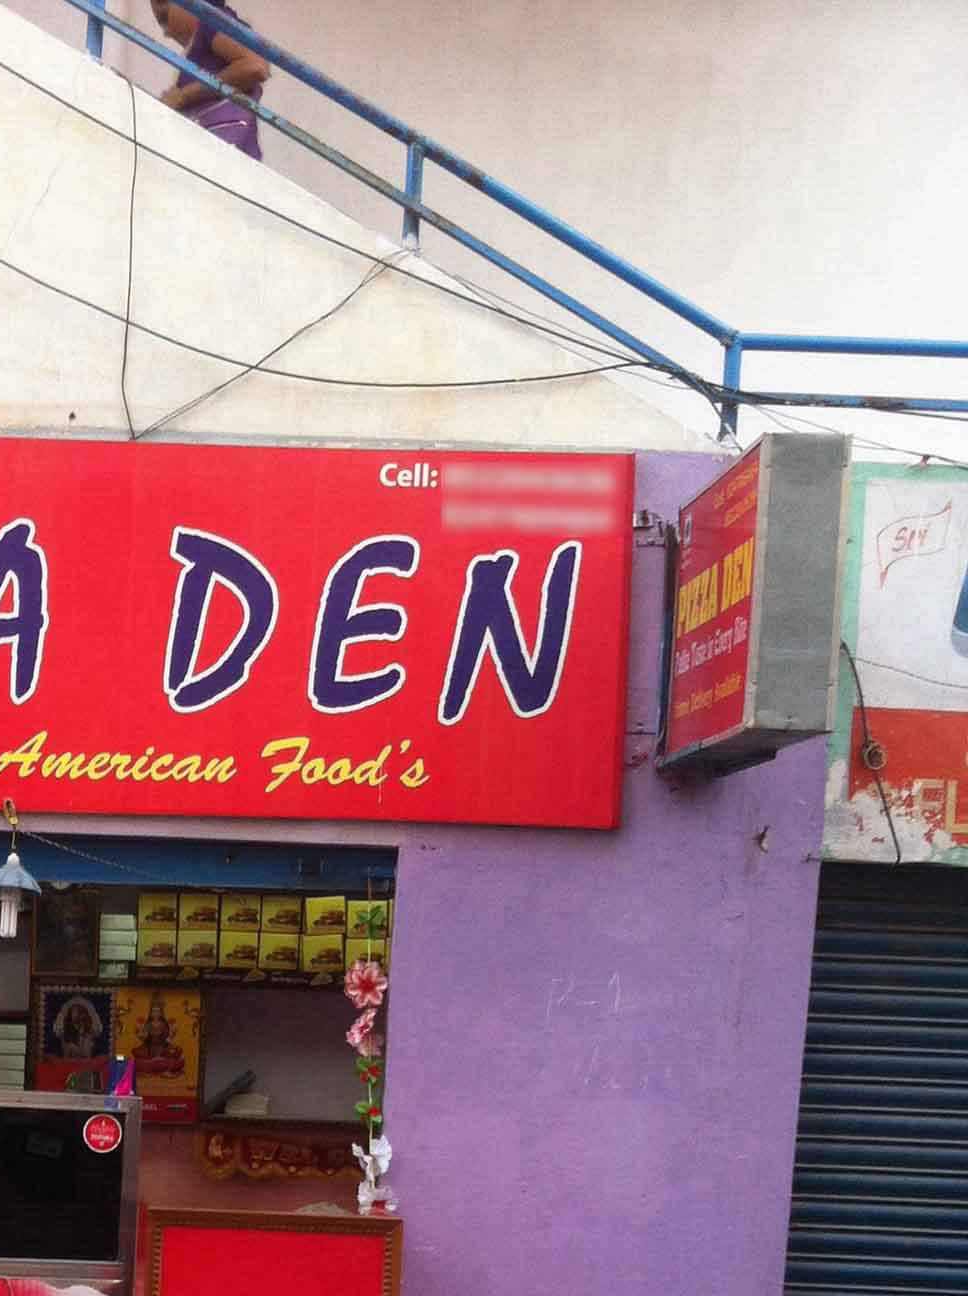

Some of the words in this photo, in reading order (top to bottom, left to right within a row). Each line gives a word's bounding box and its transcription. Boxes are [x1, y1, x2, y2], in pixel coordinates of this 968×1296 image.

[379, 463, 438, 488] Cell:
[163, 526, 582, 725] DEN
[676, 562, 718, 640] PIZZA
[720, 536, 754, 613] DEN
[260, 736, 429, 792] Food's
